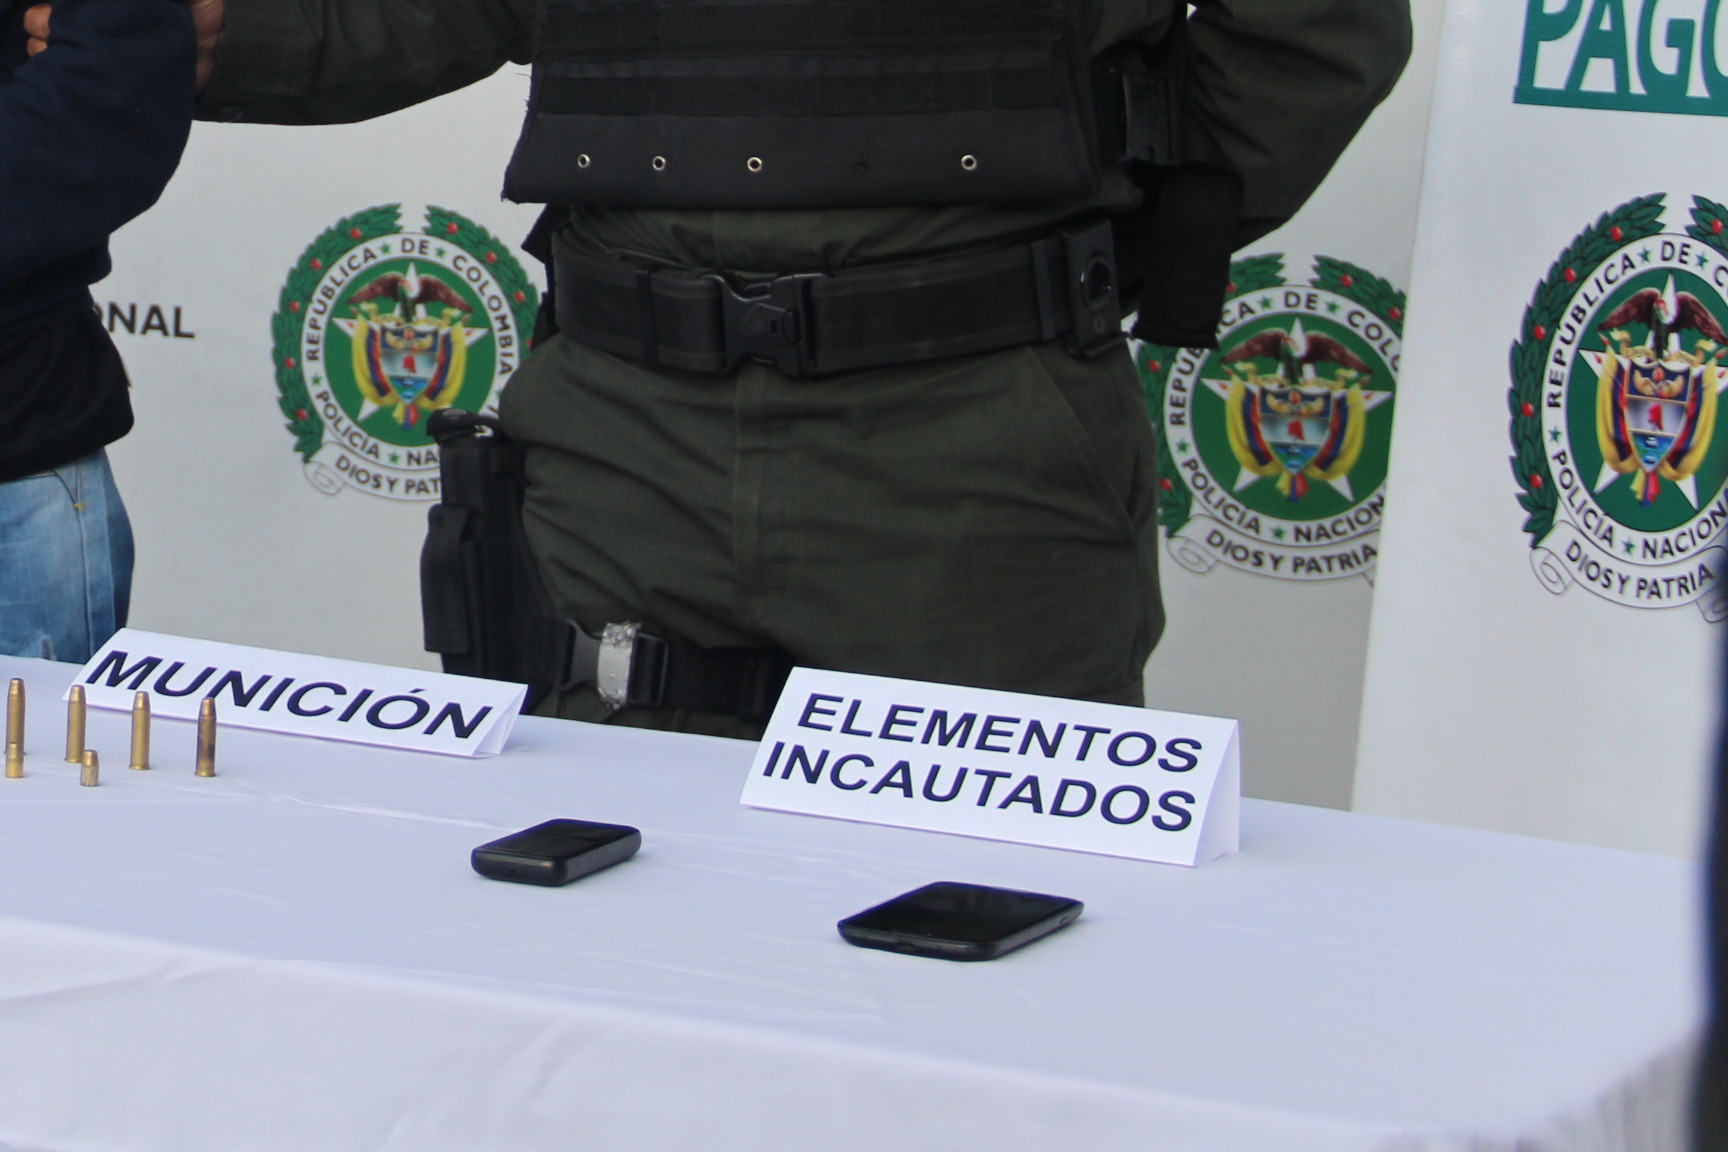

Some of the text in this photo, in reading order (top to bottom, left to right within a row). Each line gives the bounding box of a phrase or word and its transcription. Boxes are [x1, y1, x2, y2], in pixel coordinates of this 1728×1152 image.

[1661, 241, 1690, 265] DE
[401, 238, 428, 255] DE
[453, 256, 512, 375] COLOMBIA
[1284, 292, 1317, 310] DE
[1293, 543, 1375, 574] PATRIA
[1637, 562, 1713, 600] PATRIA
[84, 649, 494, 740] MUNICIÓN
[797, 692, 1203, 773] ELEMENTOS
[762, 741, 1196, 833] INCAUTADOS
